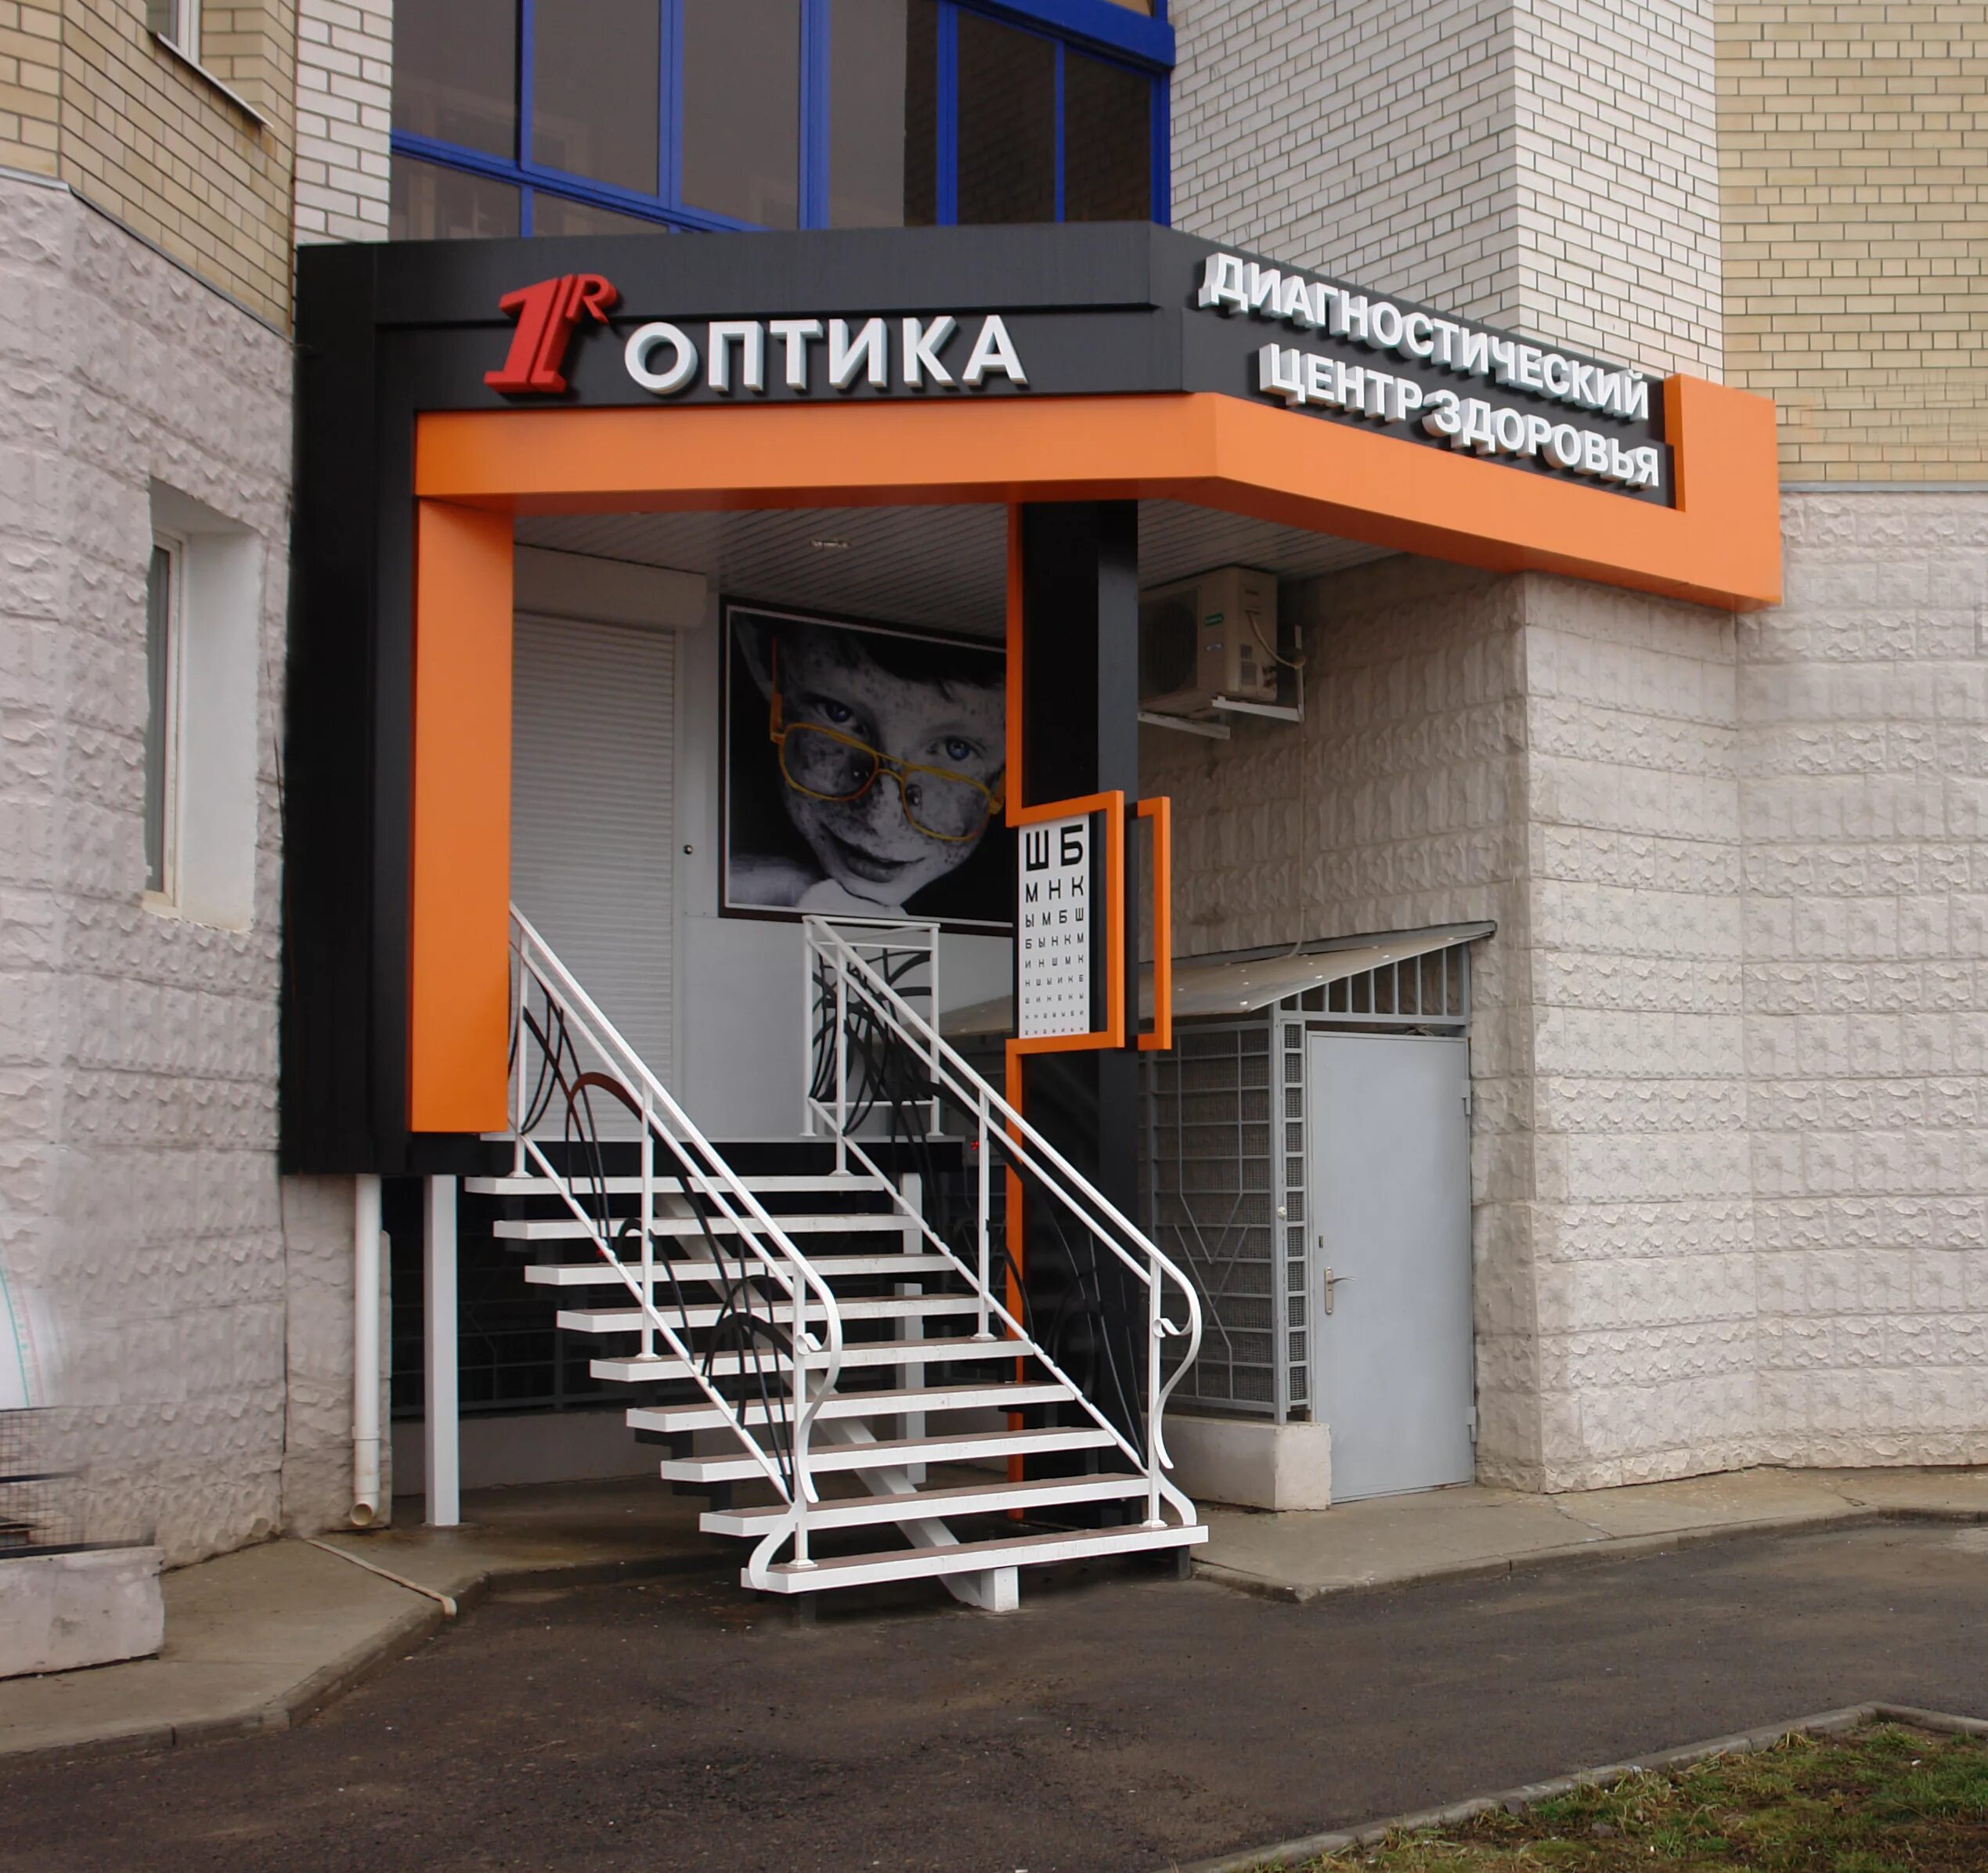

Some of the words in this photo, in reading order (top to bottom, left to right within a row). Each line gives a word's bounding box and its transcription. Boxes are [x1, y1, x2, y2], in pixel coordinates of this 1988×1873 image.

[624, 315, 1028, 394] ОПТИКА
[1198, 252, 1649, 421] ДИАГНОСТИЧЕСКИЙ
[1258, 343, 1423, 422] ЦЕНТР
[1422, 389, 1659, 489] ЗДОРОВЬЯ
